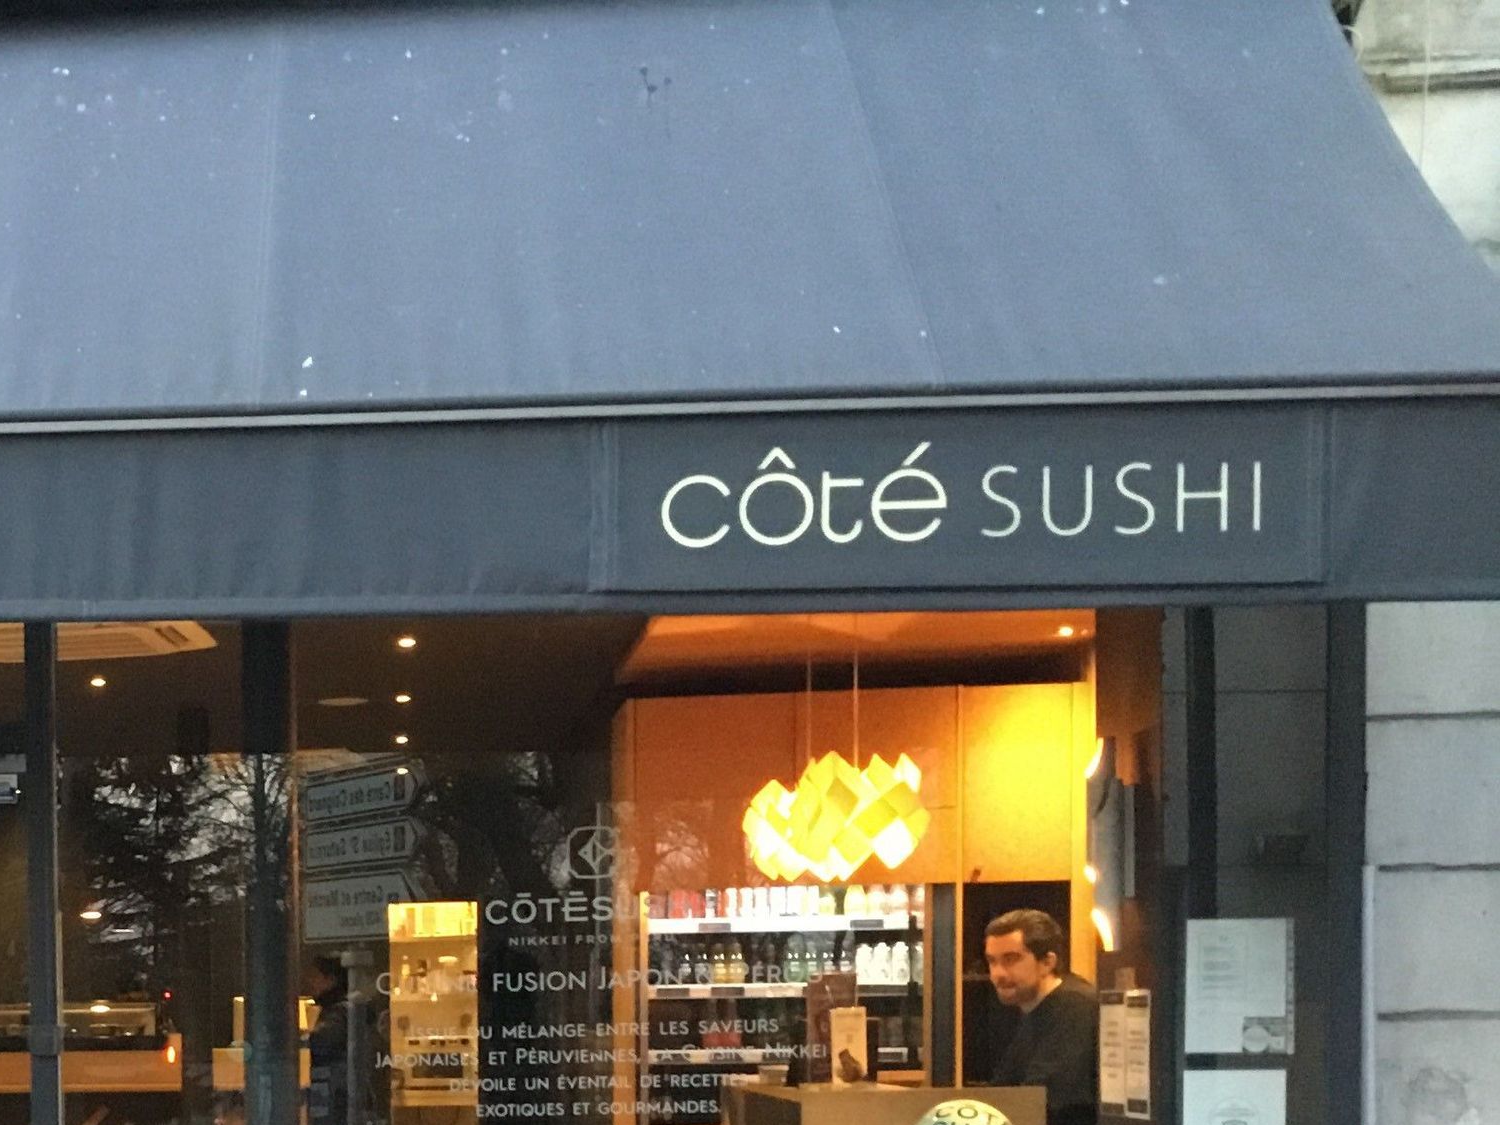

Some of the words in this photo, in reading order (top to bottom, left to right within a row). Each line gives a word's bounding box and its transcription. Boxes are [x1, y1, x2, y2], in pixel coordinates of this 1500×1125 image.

[981, 460, 1262, 538] SUSHI
[508, 934, 568, 947] NIKKEI
[492, 970, 587, 993] FUSION
[596, 965, 683, 991] JAPON
[501, 1021, 587, 1040] MÉLANGE
[595, 1021, 650, 1038] ENTRE
[659, 1020, 690, 1036] LES
[698, 1018, 780, 1034] SAVEURS
[487, 1050, 508, 1066] ET
[764, 1041, 827, 1060] NIKKEI
[524, 1077, 550, 1091] UN
[639, 1074, 663, 1089] DE
[475, 1102, 565, 1119] EXOTIQUES
[572, 1101, 591, 1116] ET
